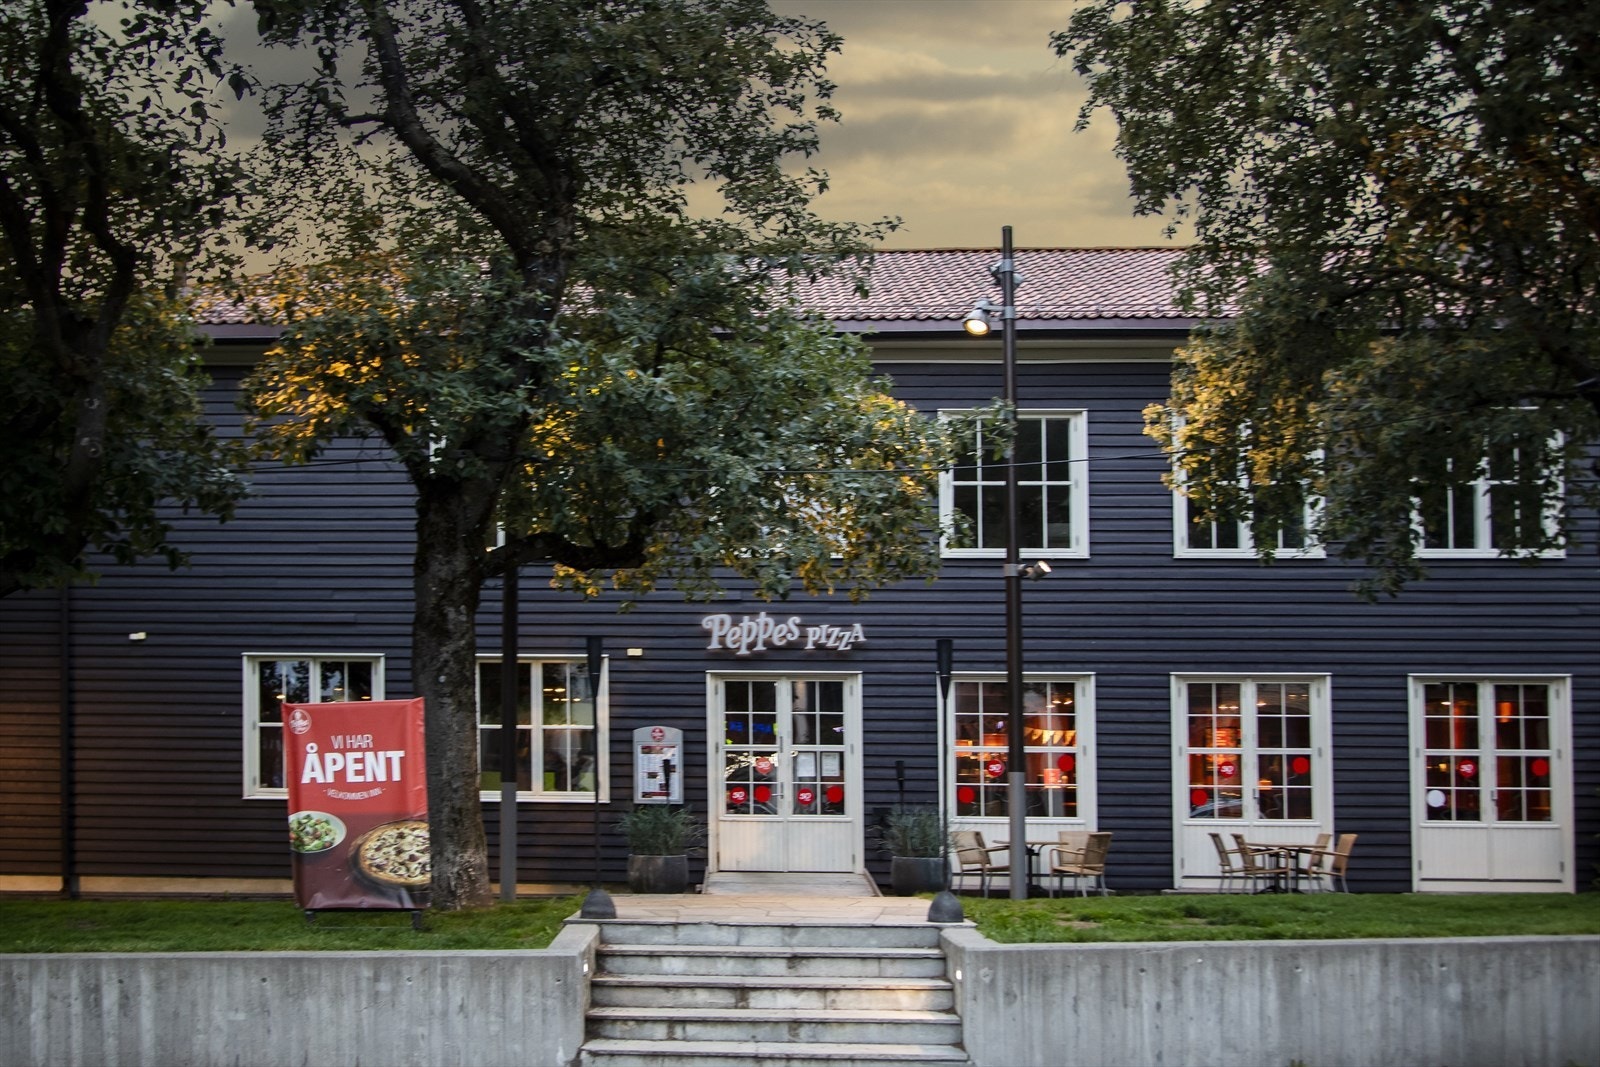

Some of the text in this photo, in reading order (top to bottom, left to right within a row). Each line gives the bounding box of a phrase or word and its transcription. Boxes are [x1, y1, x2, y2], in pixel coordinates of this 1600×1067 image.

[702, 611, 867, 655] Peppes PIZZA
[331, 734, 373, 749] VI HAR
[301, 743, 405, 783] ÅPENT
